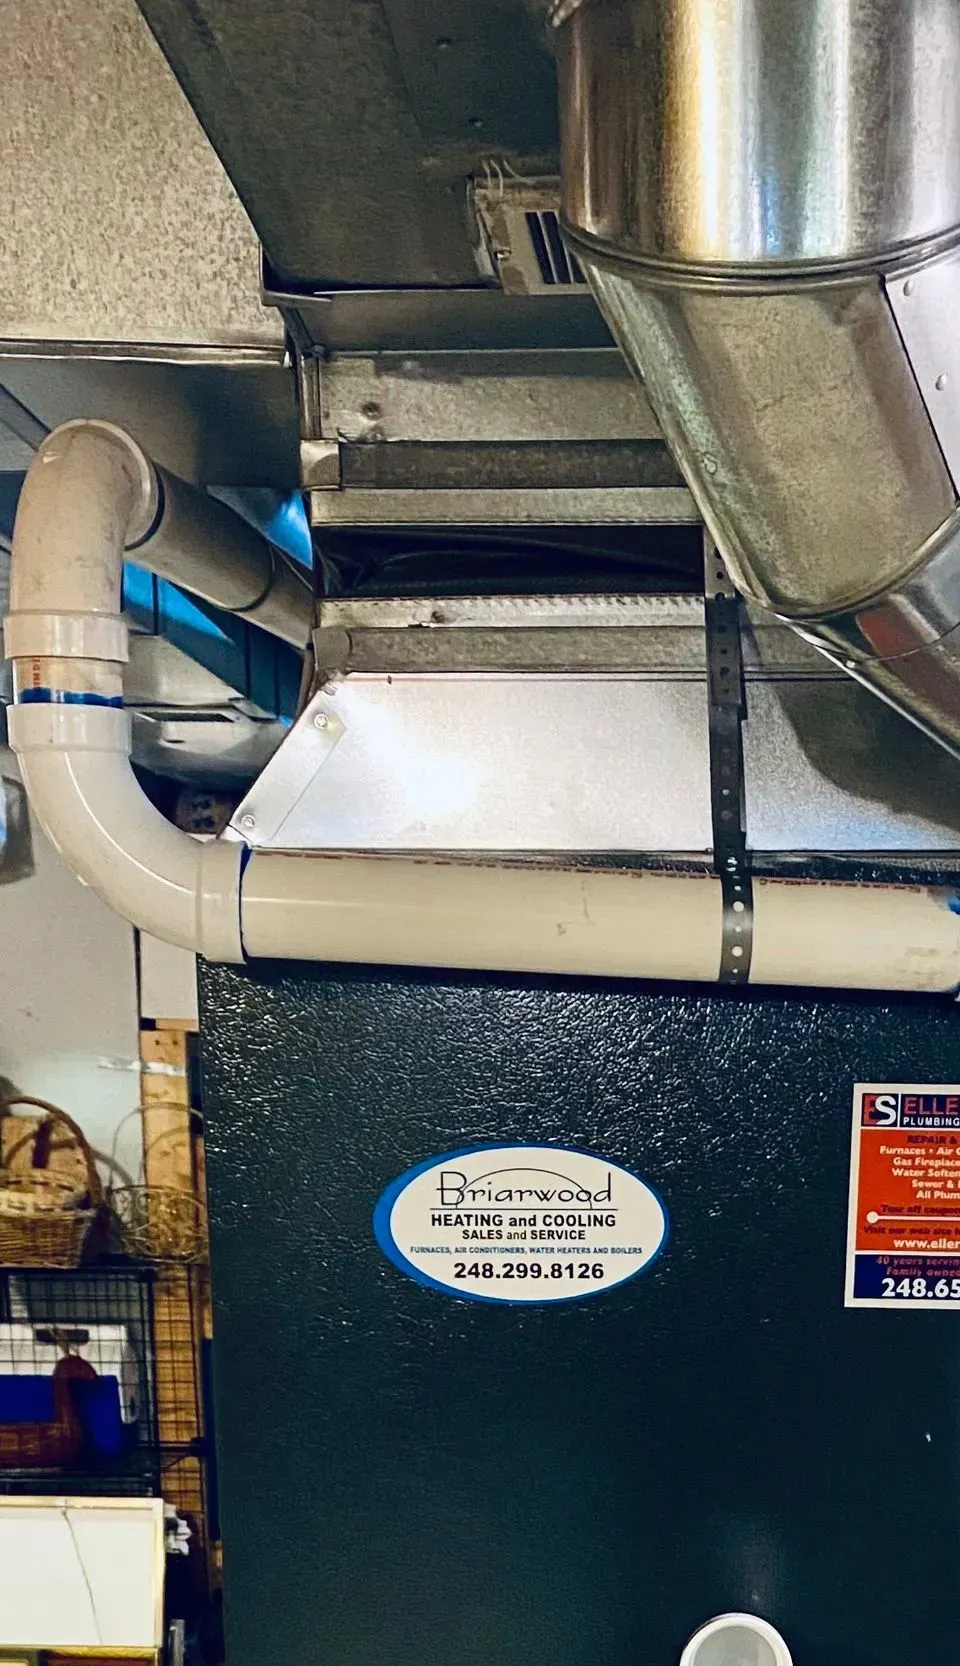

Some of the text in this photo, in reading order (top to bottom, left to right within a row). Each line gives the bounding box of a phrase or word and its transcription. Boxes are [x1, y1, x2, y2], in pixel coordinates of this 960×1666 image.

[903, 1117, 960, 1127] PLUMBING
[880, 1146, 926, 1156] Furnaces
[937, 1146, 953, 1156] Air
[893, 1157, 912, 1166] Gas
[891, 1168, 924, 1178] Water
[436, 1171, 612, 1206] Briarwood
[912, 1180, 944, 1188] Sewer
[947, 1180, 954, 1189] &
[916, 1190, 932, 1199] All
[431, 1214, 616, 1227] HEATING and COOLING
[462, 1229, 586, 1240] SALES and SERVICE
[410, 1246, 452, 1255] FURNACES,
[454, 1246, 467, 1254] AIR
[469, 1246, 528, 1255] CONDITIONERS,
[454, 1262, 604, 1279] 248.299.8126
